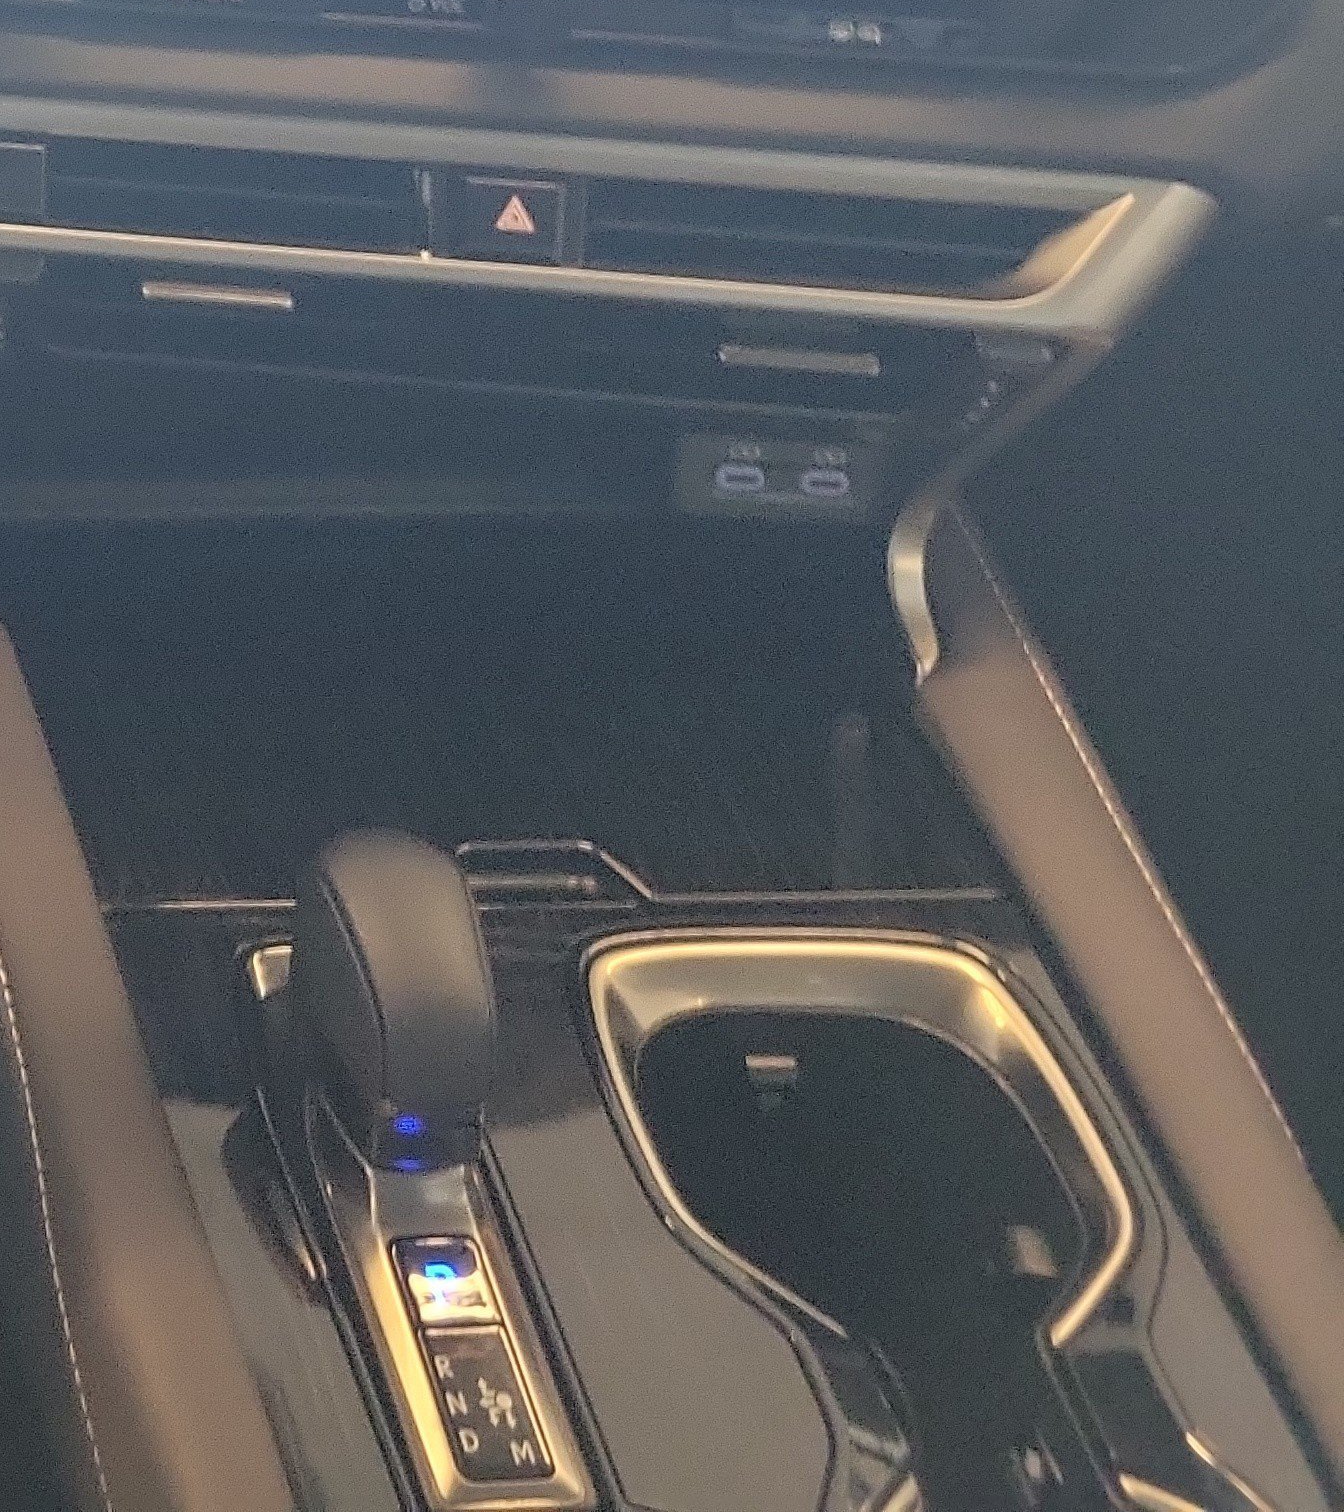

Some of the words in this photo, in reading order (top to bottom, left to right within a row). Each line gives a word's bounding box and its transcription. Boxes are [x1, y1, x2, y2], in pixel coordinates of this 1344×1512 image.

[434, 1354, 454, 1379] R
[445, 1390, 467, 1416] N
[458, 1429, 480, 1454] D
[509, 1439, 536, 1466] M
